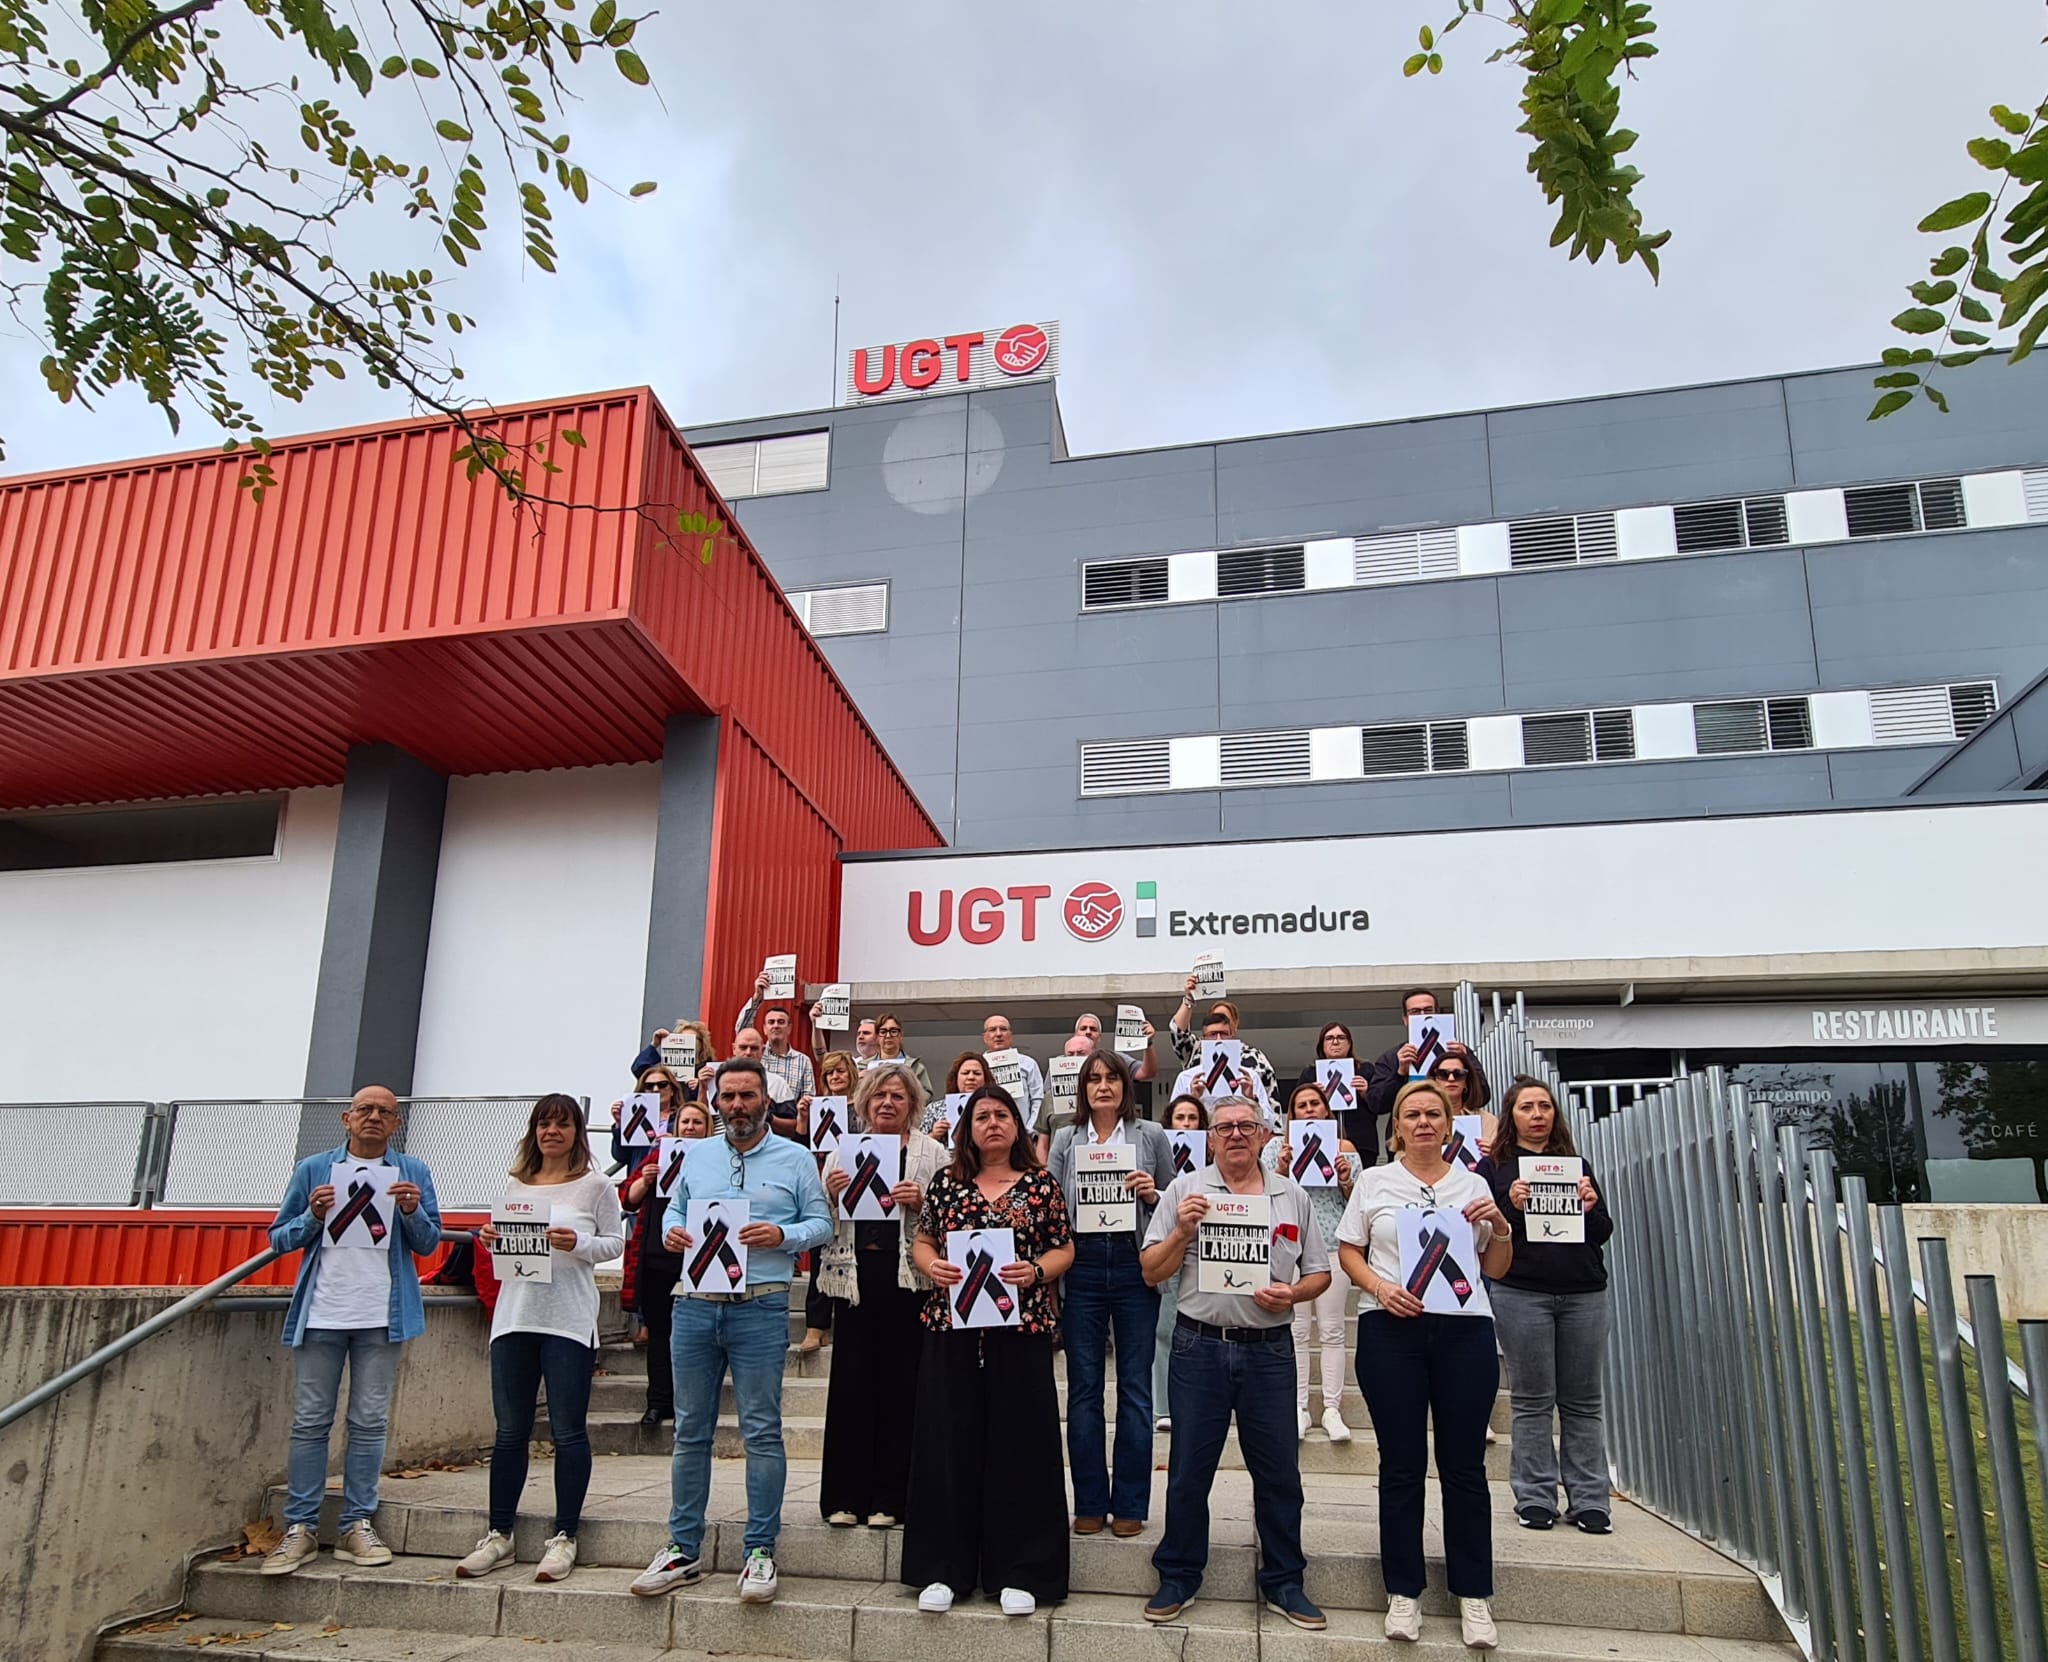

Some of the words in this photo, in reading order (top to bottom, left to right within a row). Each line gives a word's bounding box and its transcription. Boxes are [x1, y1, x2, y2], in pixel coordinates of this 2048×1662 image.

[854, 332, 984, 395] UGT
[908, 885, 1051, 945] UGT
[1170, 905, 1370, 936] Extremadura
[1812, 1007, 1999, 1040] RESTAURANTE
[1748, 1089, 1832, 1104] ruzcampo
[1991, 1121, 2039, 1138] CAFÉ
[1079, 1186, 1135, 1203] LABORAL
[1530, 1184, 1577, 1194] NIESTRALIDA
[1216, 1203, 1235, 1211] UGT
[1526, 1197, 1582, 1214] LABORAL
[1201, 1225, 1269, 1238] SINIESTRALIDAD
[493, 1237, 550, 1254] LABORAL
[1202, 1240, 1267, 1262] LABORAL
